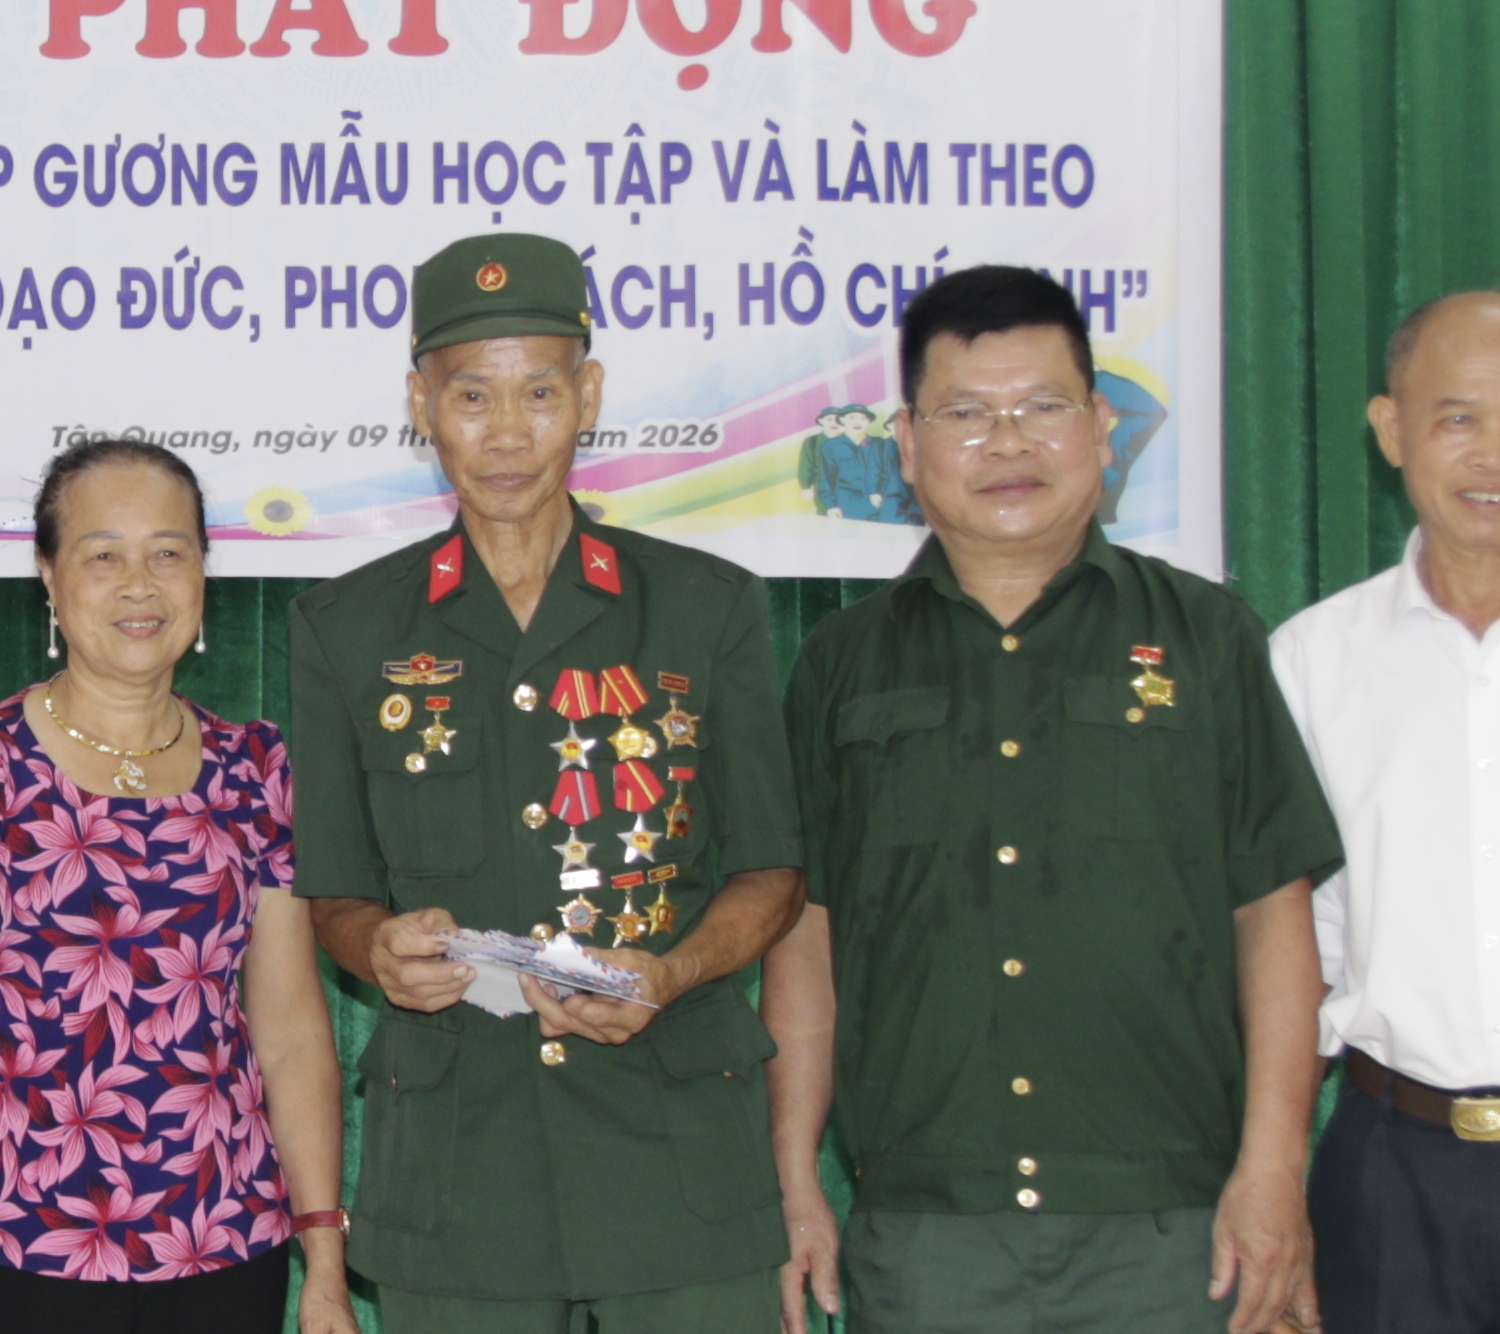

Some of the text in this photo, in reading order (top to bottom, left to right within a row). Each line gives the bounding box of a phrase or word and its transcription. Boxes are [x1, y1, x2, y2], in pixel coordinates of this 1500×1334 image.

[34, 134, 259, 208] GƯƠNG
[281, 110, 409, 206] MẪU
[433, 140, 567, 225] HỌC
[586, 122, 693, 225] TẬP
[712, 117, 795, 204] VÀ
[816, 118, 930, 205] LÀM
[949, 142, 1095, 209] THEO
[117, 246, 261, 343] ĐỨC,
[737, 225, 826, 329] HỒ
[118, 425, 240, 455] Quang,
[252, 423, 338, 455] ngày
[347, 424, 388, 447] 09
[638, 423, 719, 448] 2026
